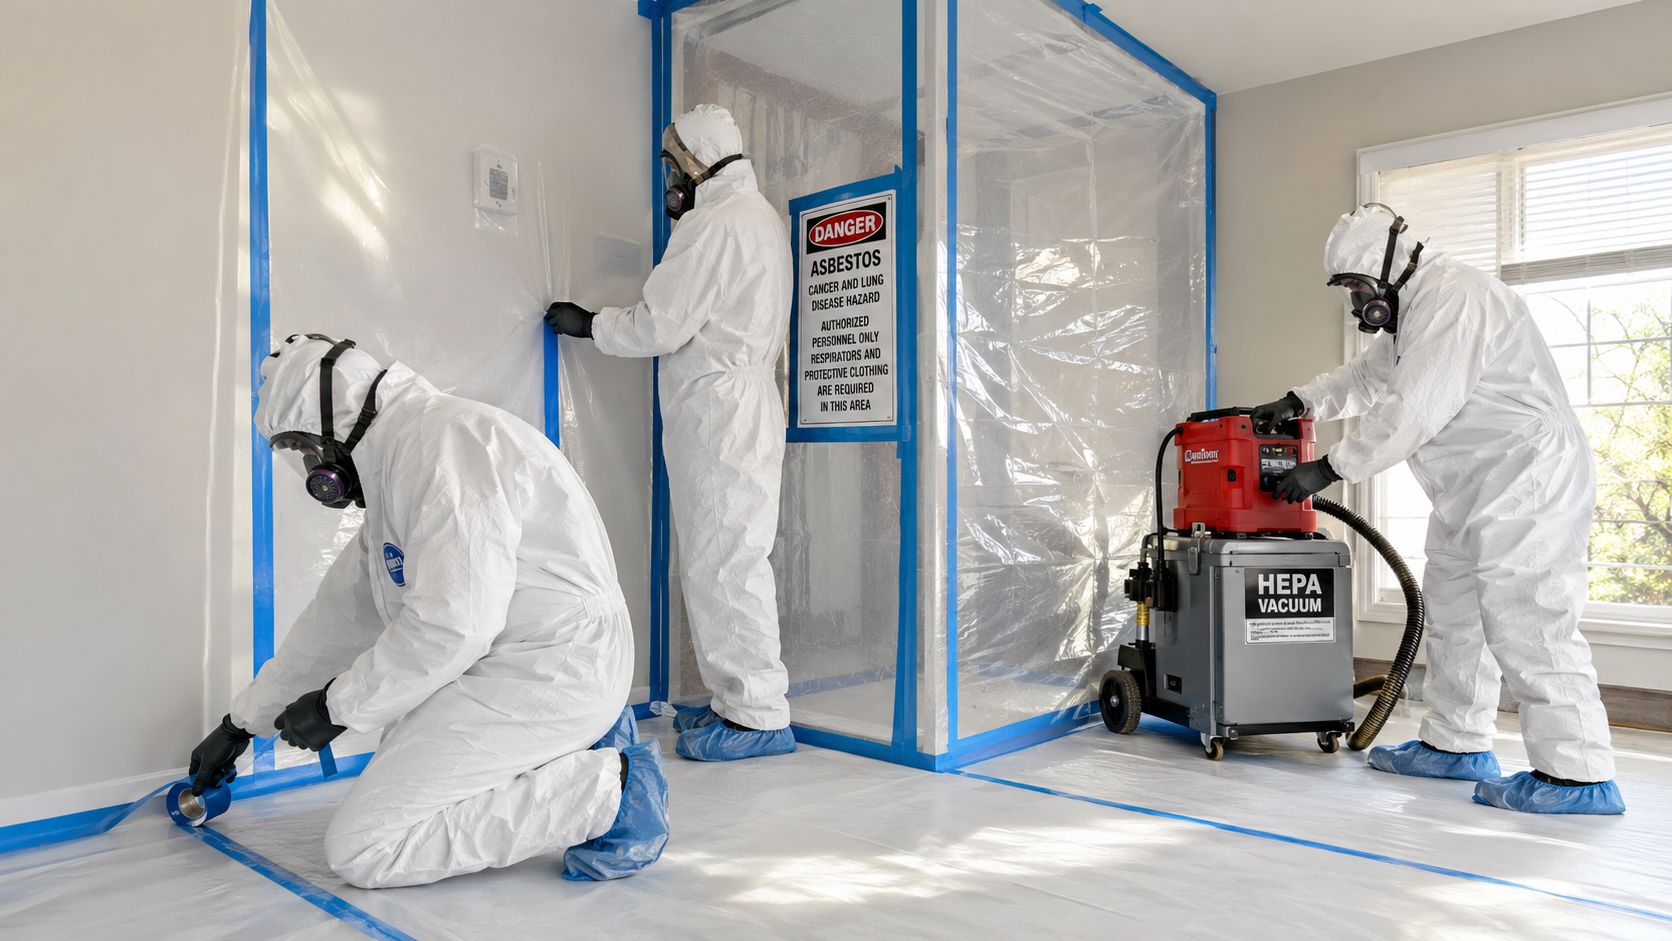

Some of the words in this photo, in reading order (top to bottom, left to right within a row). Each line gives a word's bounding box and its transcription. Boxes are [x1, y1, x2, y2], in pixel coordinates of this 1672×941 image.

[815, 215, 876, 242] DANGER
[810, 249, 881, 277] ASBESTOS
[808, 281, 840, 296] CANCER
[841, 278, 858, 291] AND
[861, 274, 884, 288] LUNG
[812, 294, 844, 311] DISEASE
[847, 291, 880, 306] HAZARD
[821, 316, 869, 331] AUTHORIZED
[813, 334, 856, 348] PERSONNEL
[859, 331, 879, 343] ONLY
[811, 350, 862, 364] RESPIRATORS
[864, 348, 881, 359] AND
[805, 367, 847, 380] PROTECTIVE
[850, 364, 888, 377] CLOTHING
[817, 384, 832, 396] ARE
[835, 382, 874, 395] REQUIRED
[821, 401, 828, 412] IN
[830, 400, 847, 411] THIS
[850, 399, 871, 410] AREA
[1258, 574, 1322, 594] HEPA
[1258, 598, 1321, 612] VACUUM
